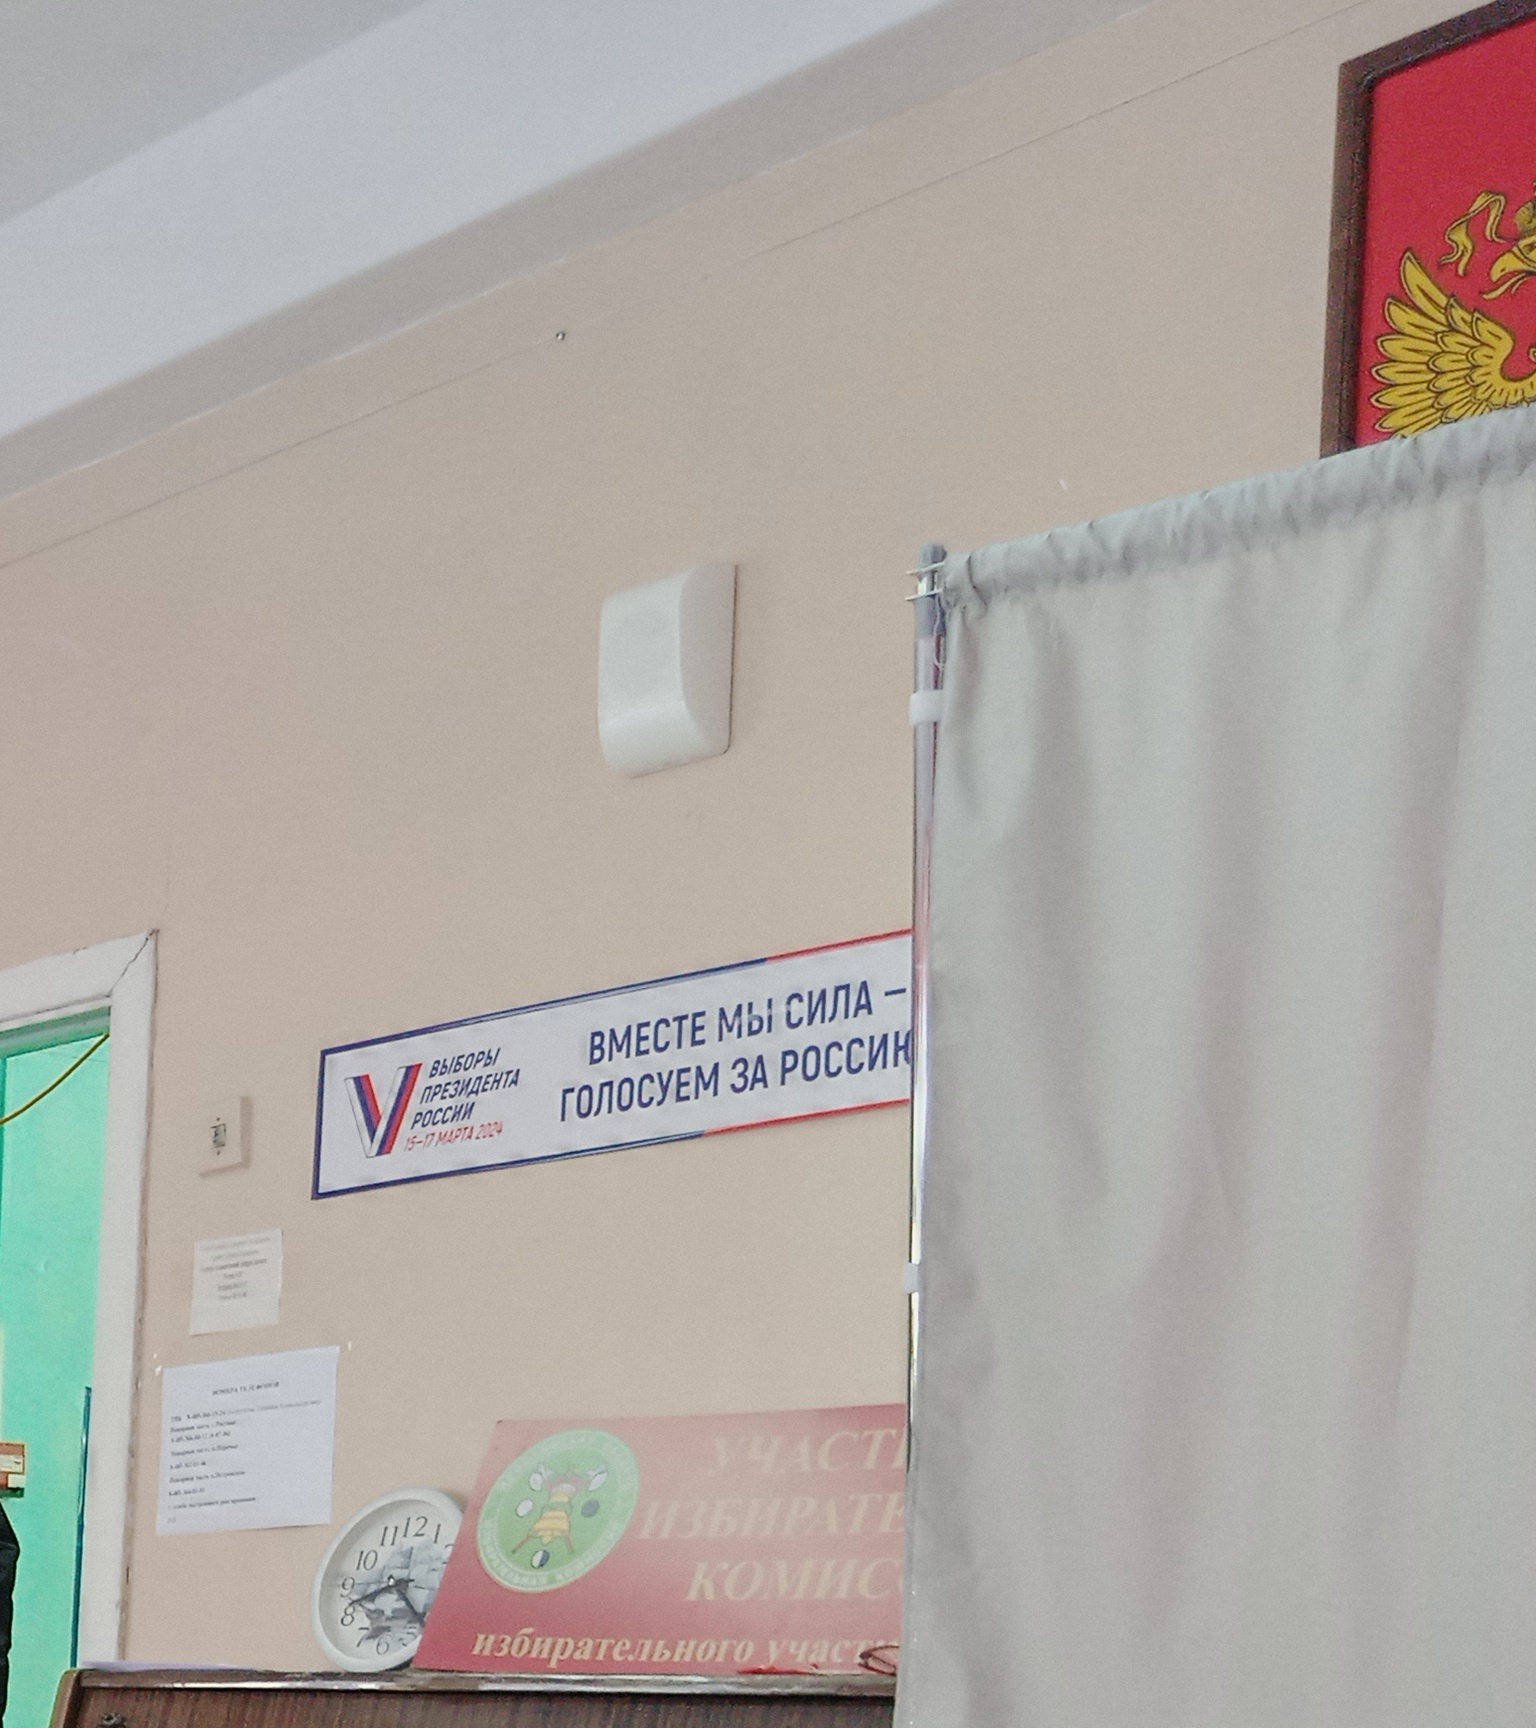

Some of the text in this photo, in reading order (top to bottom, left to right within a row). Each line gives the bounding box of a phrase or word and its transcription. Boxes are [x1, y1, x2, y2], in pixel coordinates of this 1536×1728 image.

[589, 1010, 706, 1065] ВМЕСТЕ
[718, 997, 773, 1042] МЫ
[785, 980, 873, 1030] СИЛА
[428, 1048, 501, 1078] ВЫБОРЫ
[420, 1069, 520, 1104] ПРЕЗИДЕНТА
[560, 1061, 719, 1122] ГОЛОСУЕМ
[730, 1054, 769, 1094] ЗА
[411, 1102, 476, 1130] РОССИИ
[435, 1126, 474, 1147] МАРТА
[380, 1525, 399, 1547] 11
[402, 1516, 428, 1538] 12
[433, 1524, 441, 1544] 1
[356, 1550, 378, 1571] 10
[340, 1577, 355, 1598] 9
[684, 1558, 903, 1602] КОМИС
[340, 1604, 355, 1627] 8
[356, 1627, 370, 1648] 7
[376, 1635, 391, 1655] 6
[471, 1627, 898, 1670] избирательного участ
